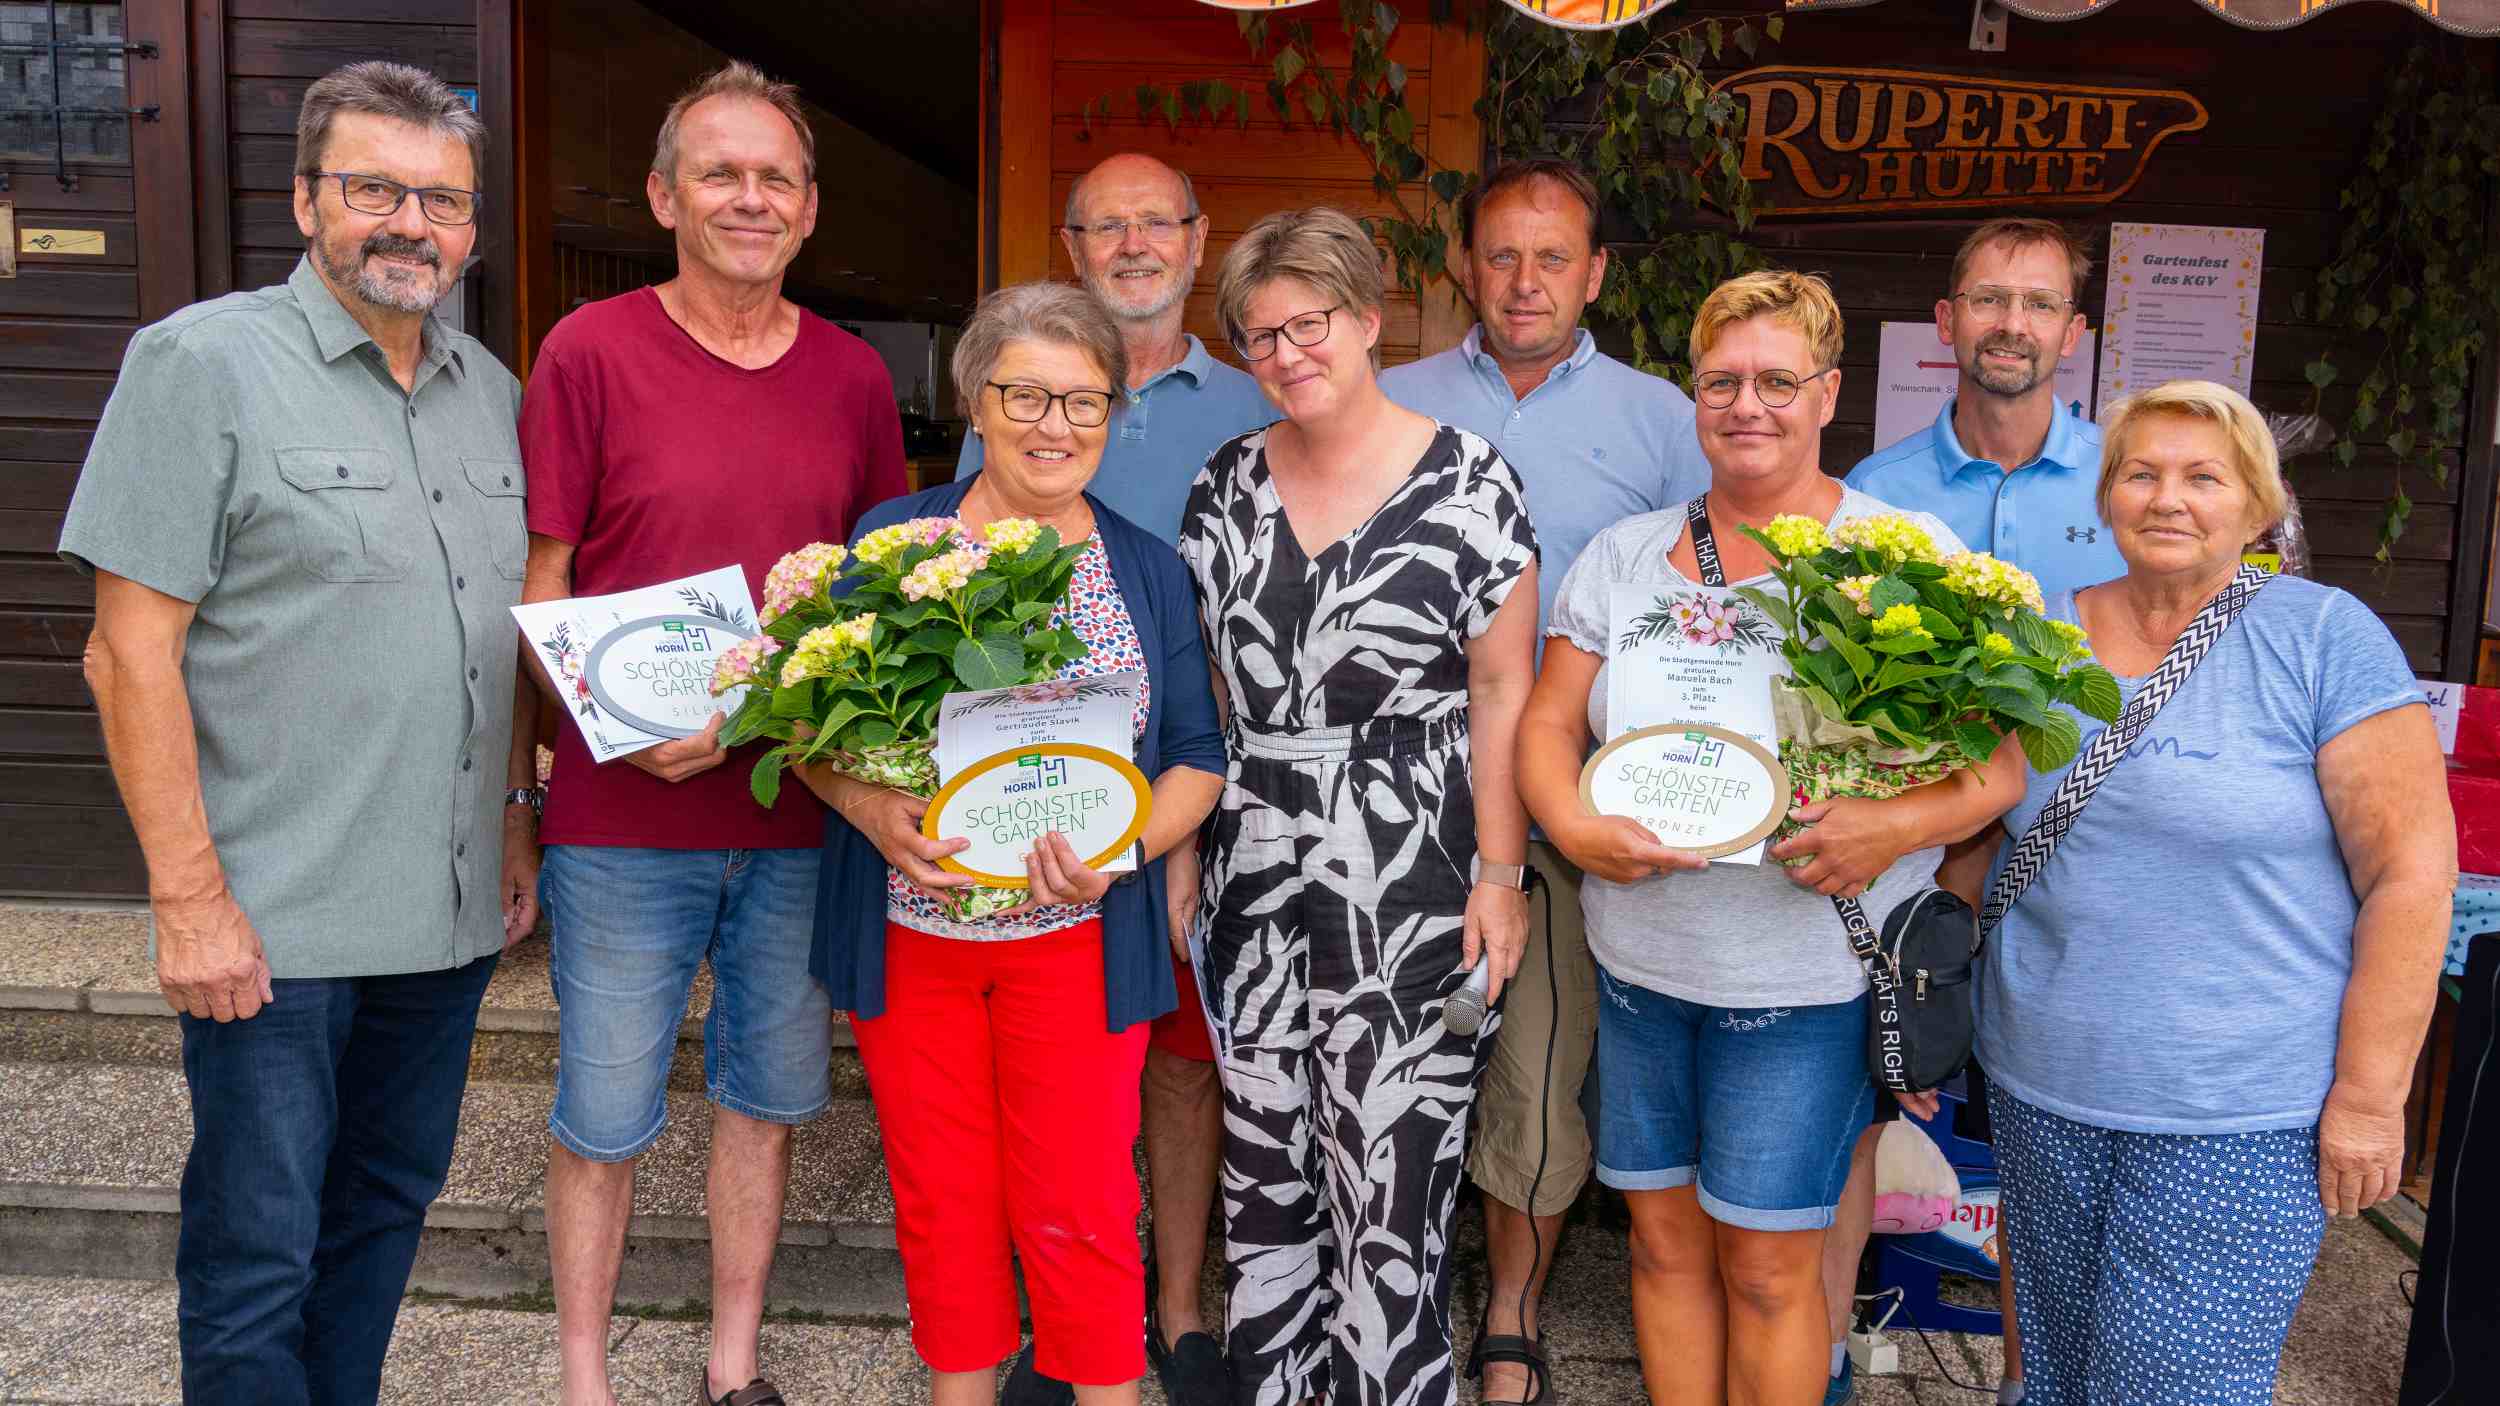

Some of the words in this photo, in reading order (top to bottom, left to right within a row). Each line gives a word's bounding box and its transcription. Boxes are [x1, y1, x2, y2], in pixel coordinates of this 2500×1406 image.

[1732, 78, 2147, 199] RUPERTI-
[1859, 149, 2106, 201] HÜTTE
[2143, 253, 2229, 269] Gartenfest
[2151, 273, 2178, 285] des
[2181, 274, 2219, 287] KGV
[1695, 533, 1723, 585] THAT'S
[655, 644, 685, 653] HORN
[623, 656, 718, 681] SCHÖNS
[1667, 674, 1707, 684] Manuela
[1709, 675, 1733, 685] Bach
[652, 677, 710, 697] GART
[1681, 693, 1690, 701] 3.
[1692, 693, 1717, 703] Platz
[1049, 717, 1080, 727] Slavik
[1031, 735, 1057, 744] Platz
[1662, 752, 1692, 764] HORN
[1003, 780, 1037, 794] HORN
[1618, 763, 1751, 801] SCHÖNSTER
[965, 787, 1110, 830] SCHÖNSTER
[1633, 785, 1721, 817] GARTEN
[992, 813, 1087, 845] GARTEN
[1836, 896, 1873, 946] RIGH
[1870, 968, 1898, 1024] HAT'S
